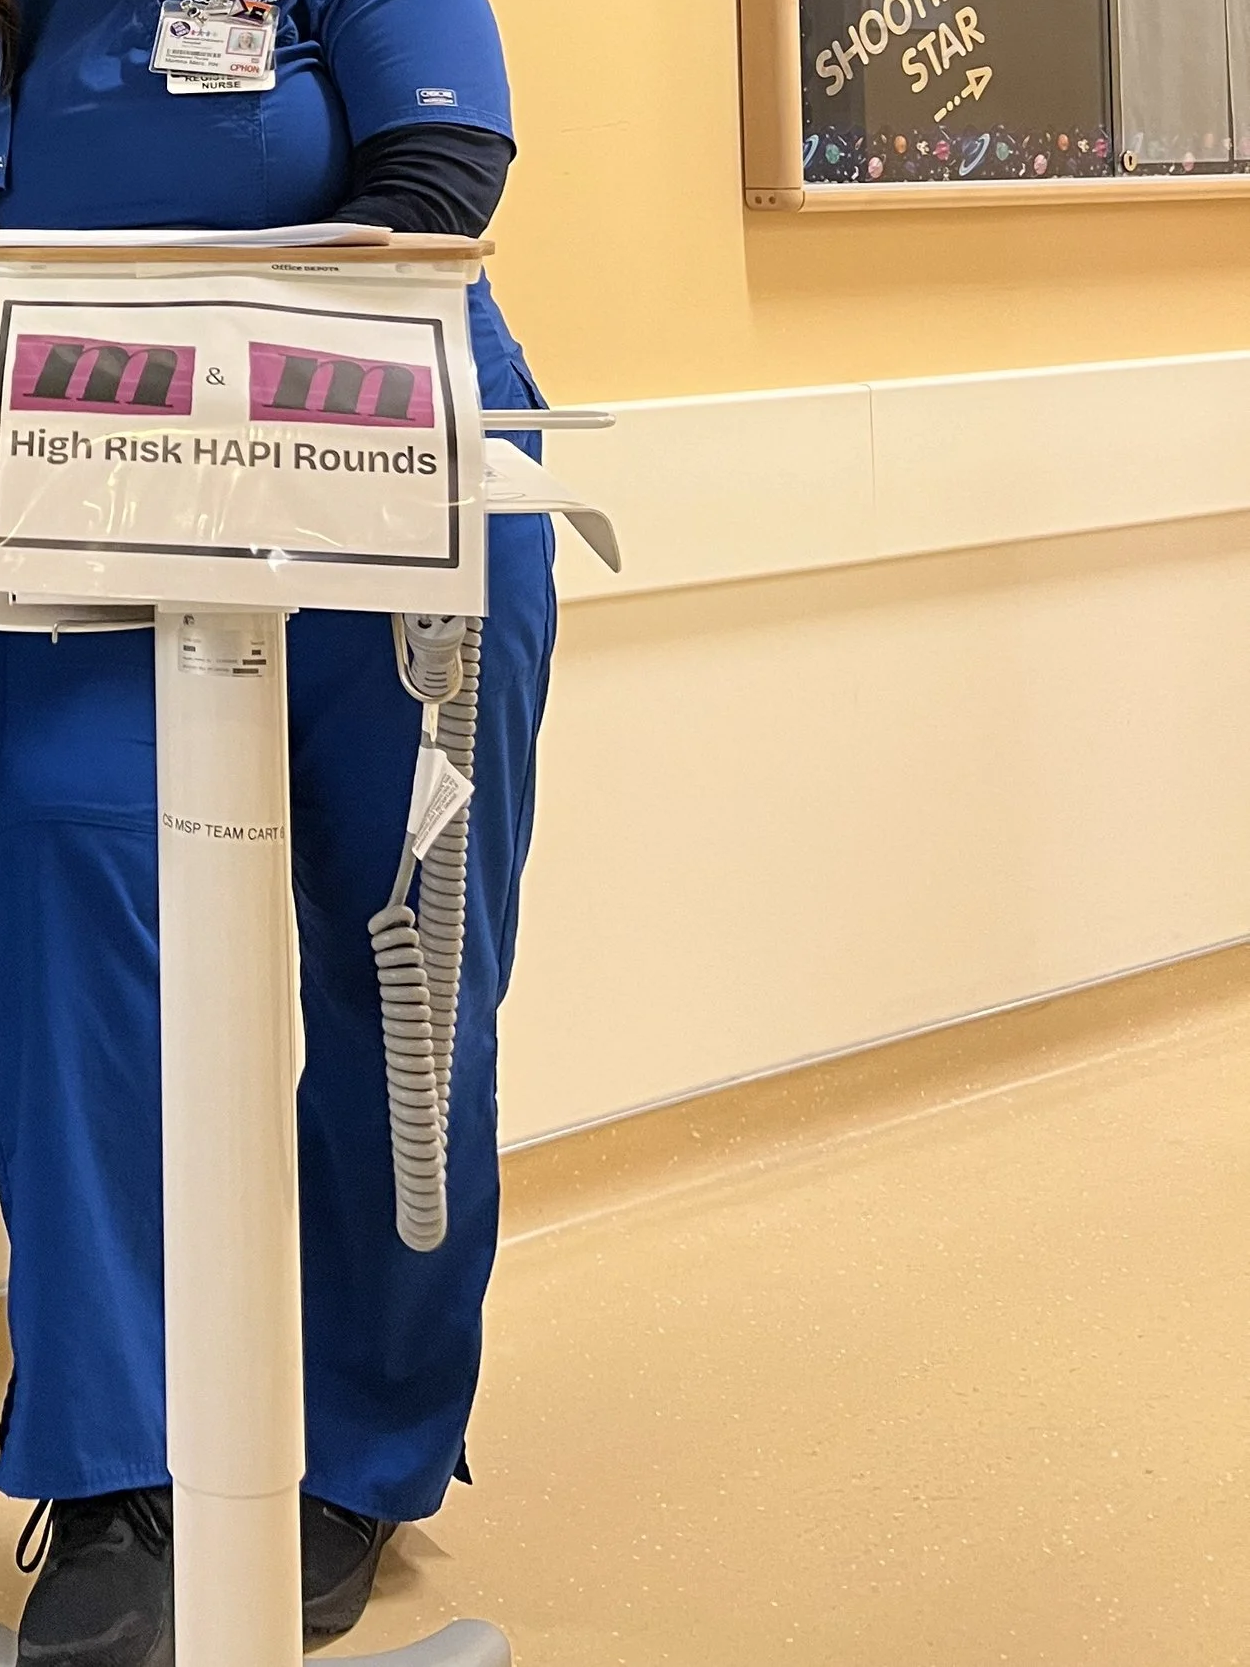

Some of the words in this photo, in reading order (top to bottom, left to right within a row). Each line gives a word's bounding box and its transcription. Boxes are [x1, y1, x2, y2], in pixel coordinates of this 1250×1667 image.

[902, 6, 986, 93] STAR
[202, 81, 241, 89] NURSE
[230, 63, 259, 73] CPHON
[23, 342, 178, 408] m
[206, 367, 225, 385] &
[262, 352, 416, 421] m
[10, 428, 92, 465] High
[105, 435, 182, 464] Risk
[193, 438, 280, 469] HAPI
[294, 442, 438, 475] Rounds
[175, 818, 201, 834] MSP
[205, 824, 244, 840] TEAM
[248, 827, 278, 841] CART
